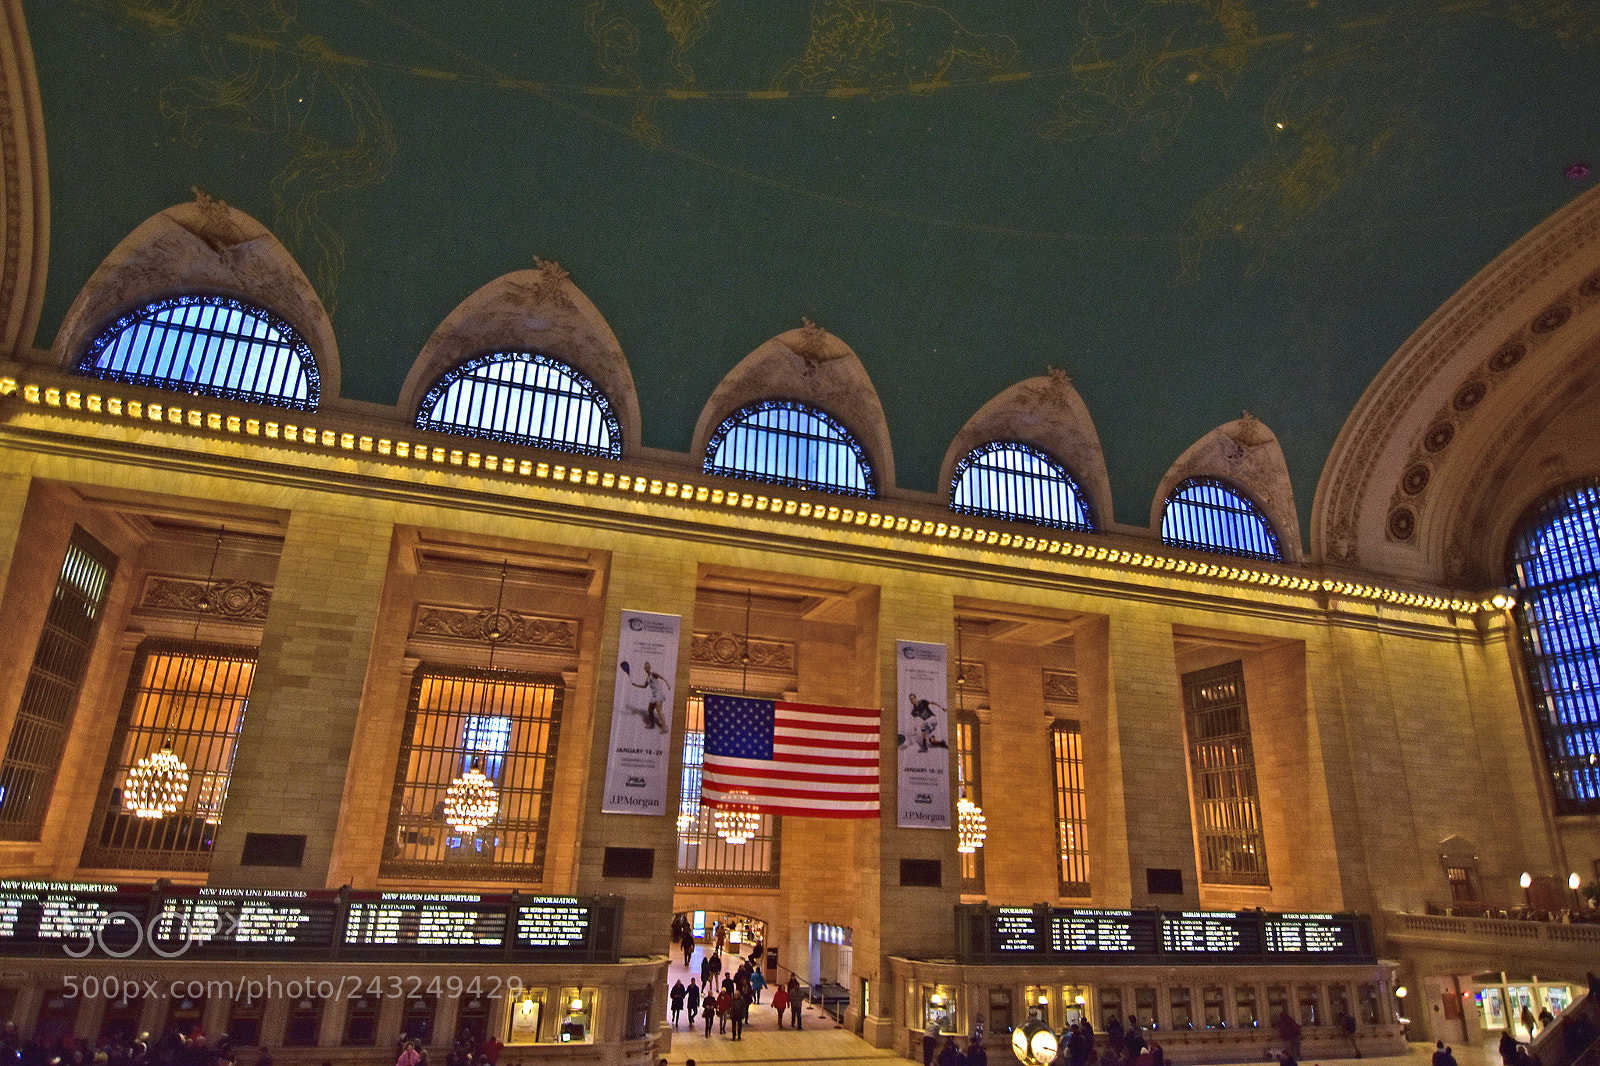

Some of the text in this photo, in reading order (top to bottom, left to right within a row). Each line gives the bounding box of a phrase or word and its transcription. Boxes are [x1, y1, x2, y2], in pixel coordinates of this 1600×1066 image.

[0, 881, 118, 892] NEW HAVEN LINE DEPARTURES
[219, 888, 244, 896] HAVEN
[263, 890, 308, 898] DEPARTURES
[400, 893, 423, 901] HAVEN
[441, 894, 481, 902] DEPARTURES
